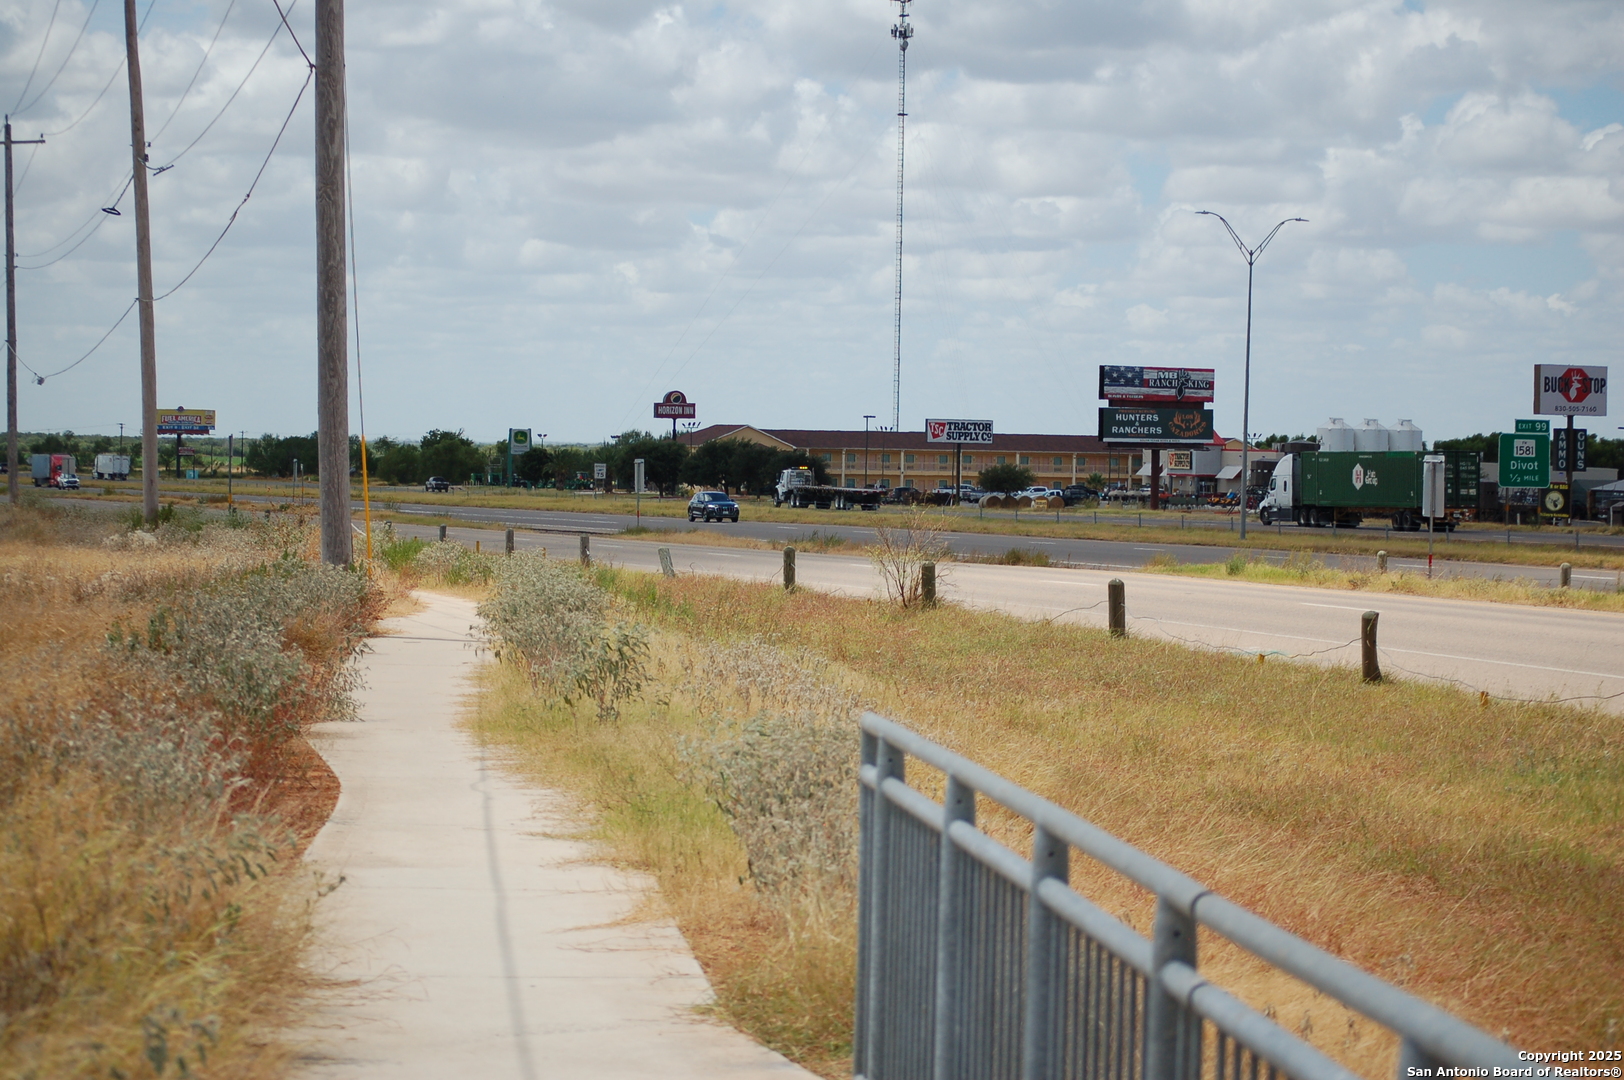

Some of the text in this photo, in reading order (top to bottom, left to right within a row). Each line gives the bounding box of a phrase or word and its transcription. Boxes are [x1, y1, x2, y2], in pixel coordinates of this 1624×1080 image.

[1149, 379, 1210, 389] RANCH KING
[1544, 376, 1606, 394] BUCK STOP
[658, 406, 694, 414] HORIZON INN
[1115, 414, 1159, 422] HUNTERS
[930, 422, 944, 437] TSC
[946, 422, 992, 432] TRACTOR
[1112, 426, 1162, 434] RANCHERS
[1535, 422, 1546, 431] 99
[946, 432, 980, 440] SUPPLY
[1516, 446, 1534, 456] 1581
[1558, 431, 1566, 468] AMMO
[1577, 432, 1586, 469] GUNS
[1510, 460, 1538, 470] Divot
